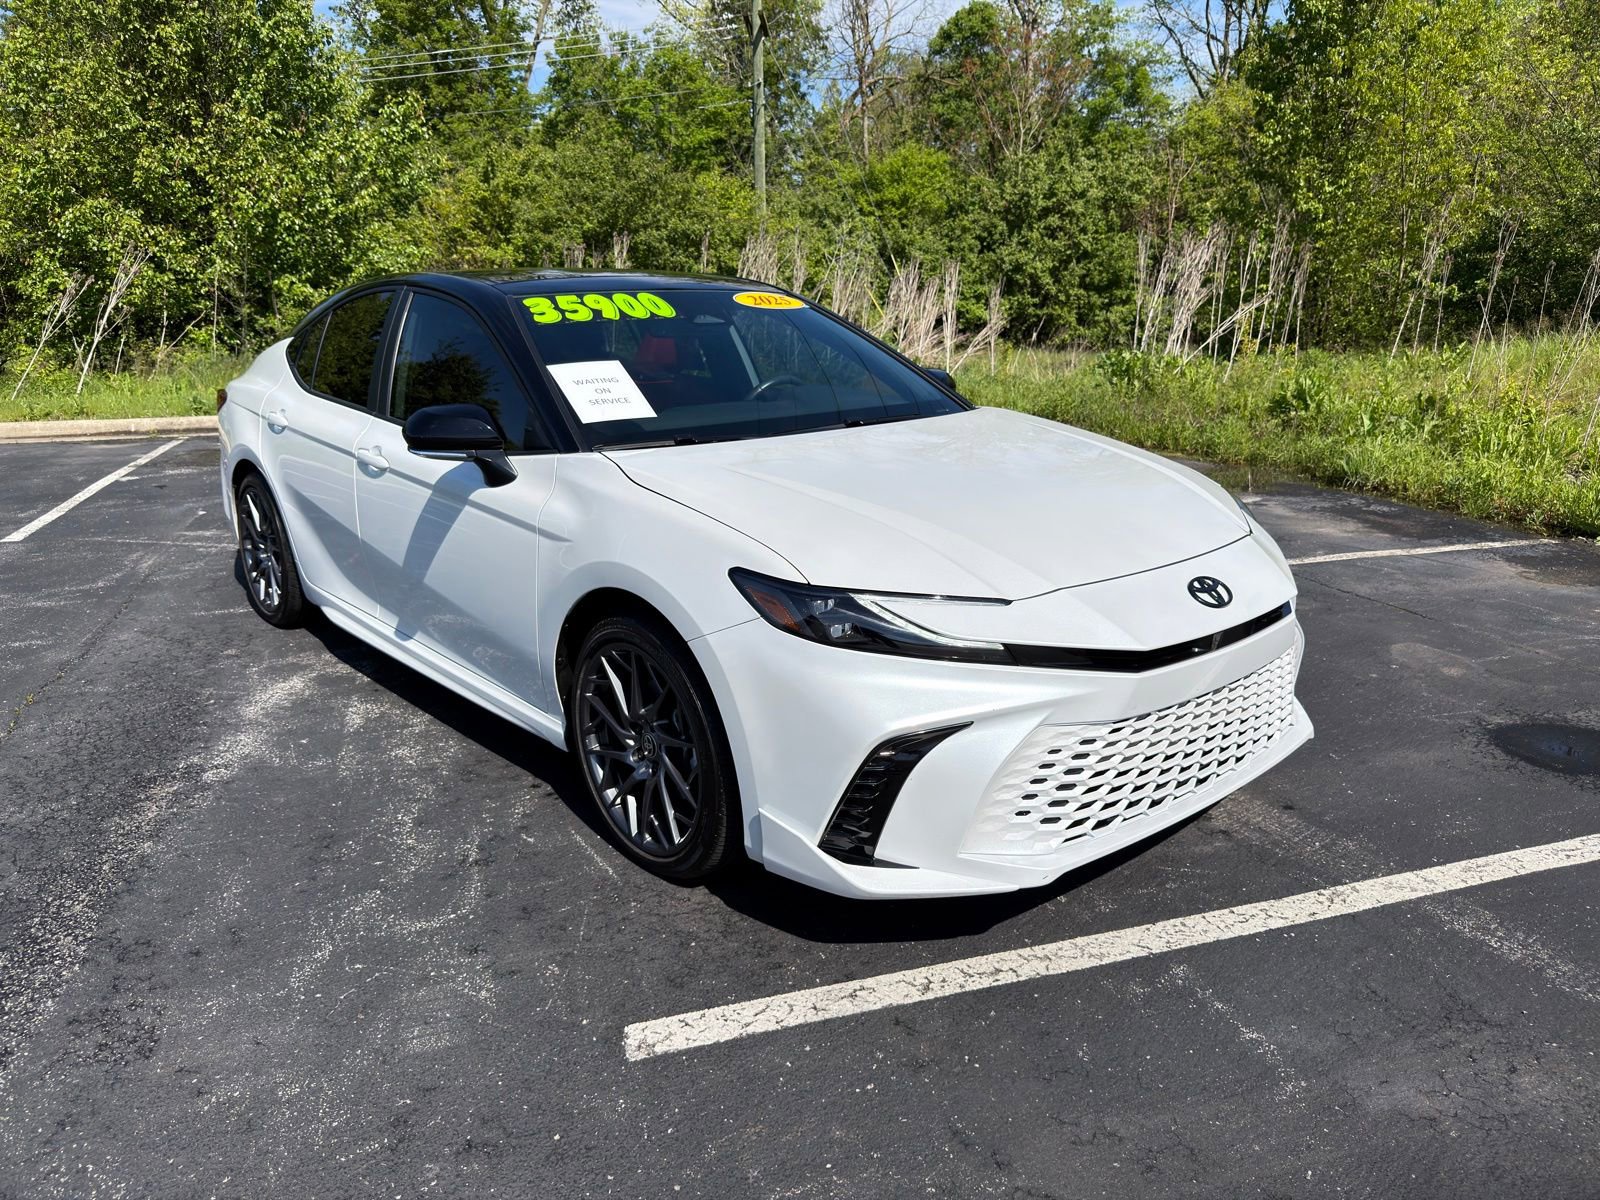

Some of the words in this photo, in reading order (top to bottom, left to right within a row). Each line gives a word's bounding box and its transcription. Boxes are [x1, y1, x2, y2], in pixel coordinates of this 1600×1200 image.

[747, 295, 791, 306] 2025
[522, 292, 676, 324] 35900
[572, 377, 619, 385] WAITING
[589, 397, 631, 405] SERVICE
